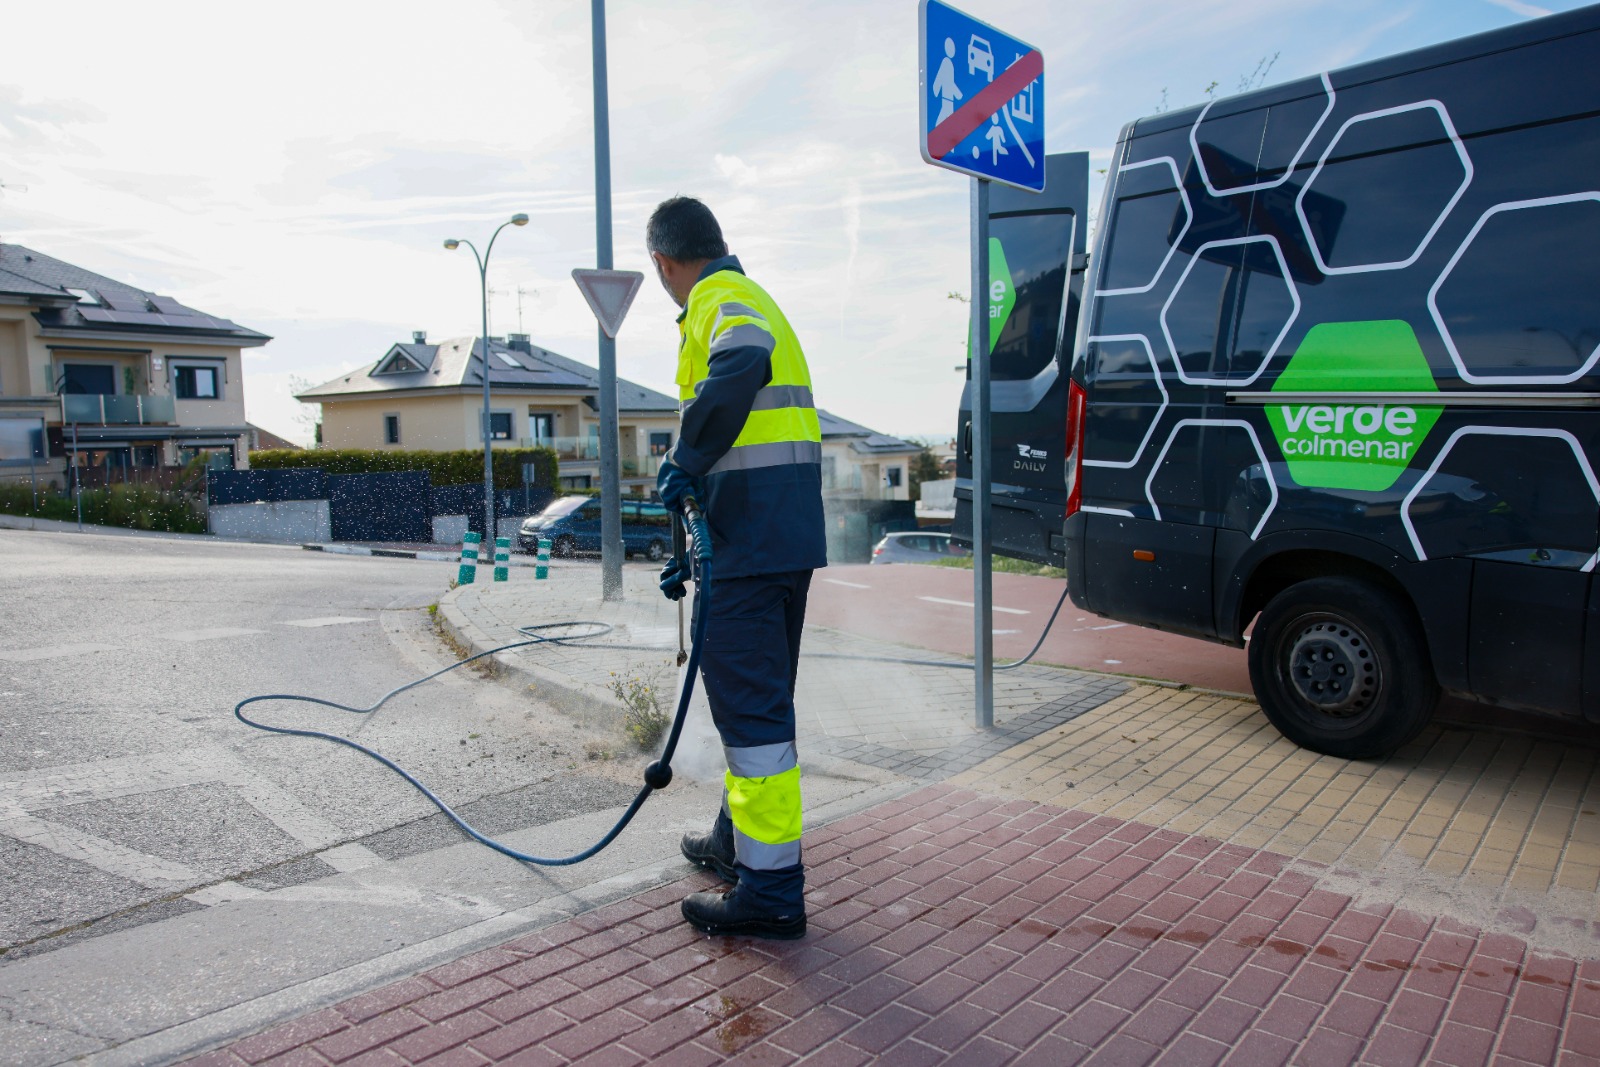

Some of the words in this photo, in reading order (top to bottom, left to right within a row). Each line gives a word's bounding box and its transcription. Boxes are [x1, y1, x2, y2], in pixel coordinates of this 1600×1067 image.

[1281, 403, 1417, 436] verde
[1282, 435, 1413, 460] colmenar
[1013, 460, 1047, 472] DAILY
